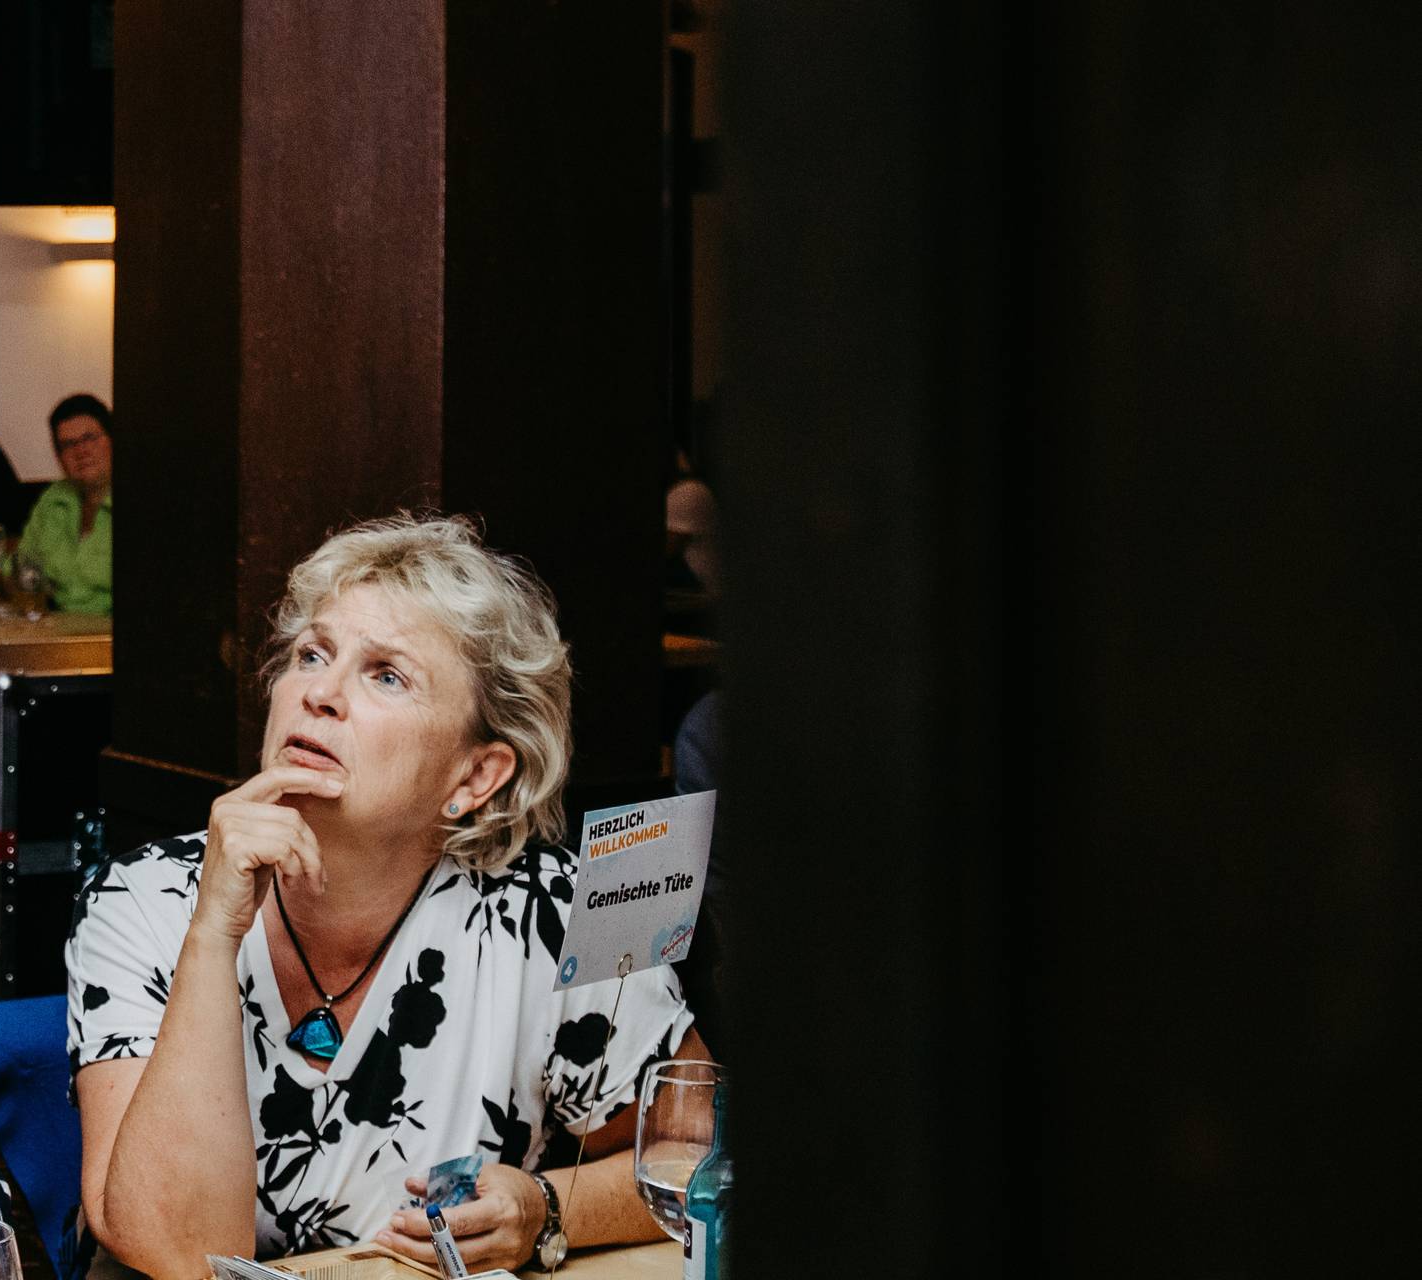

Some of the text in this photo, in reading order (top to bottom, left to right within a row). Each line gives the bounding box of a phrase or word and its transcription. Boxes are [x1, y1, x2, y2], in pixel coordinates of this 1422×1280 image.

[589, 810, 644, 840] HERZLICH
[590, 821, 668, 858] WILLKOMMEN
[587, 873, 693, 909] Gemischte Tüte
